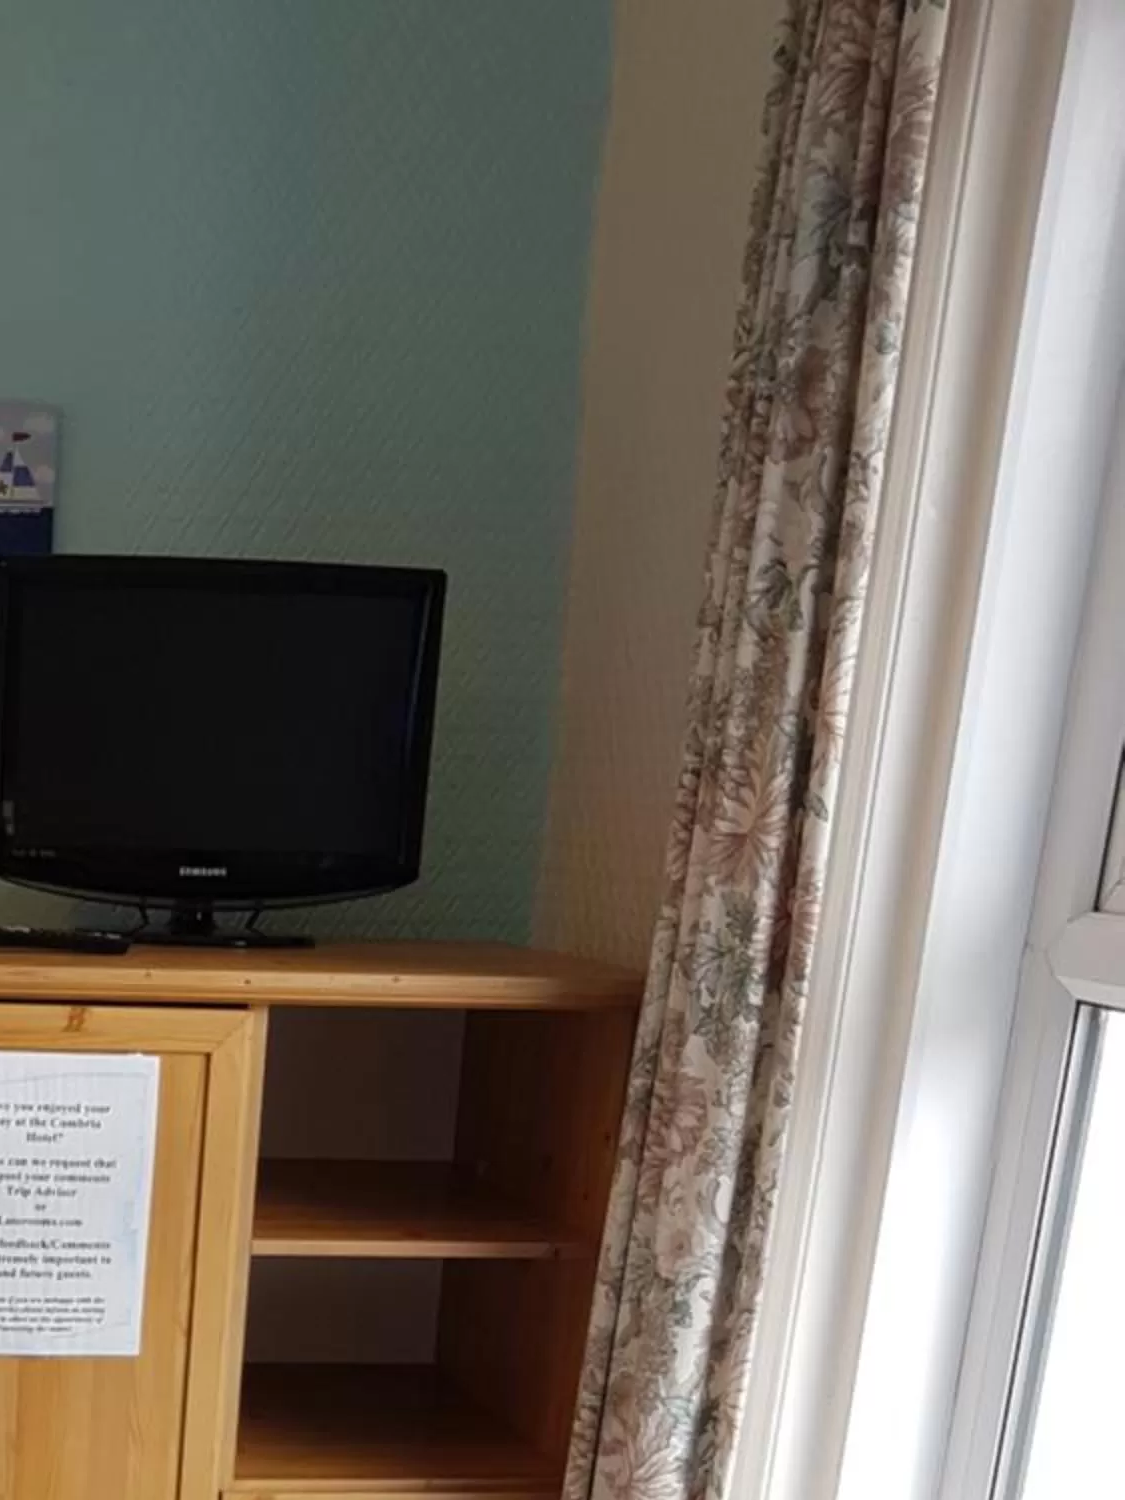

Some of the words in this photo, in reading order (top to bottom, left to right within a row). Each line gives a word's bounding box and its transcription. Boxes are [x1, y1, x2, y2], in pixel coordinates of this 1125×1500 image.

[179, 866, 227, 877] SAMSUNG
[13, 1103, 34, 1115] you
[36, 1102, 81, 1115] enjoyed
[84, 1105, 111, 1116] your
[14, 1118, 26, 1127] at
[28, 1117, 47, 1127] the
[50, 1118, 102, 1129] Cumbria
[8, 1157, 28, 1166] can
[31, 1159, 46, 1167] we
[49, 1158, 92, 1170] request
[94, 1157, 118, 1169] that
[24, 1173, 51, 1184] your
[6, 1186, 32, 1198] Trip
[34, 1204, 47, 1212] or
[41, 1255, 98, 1267] important
[100, 1256, 112, 1265] to
[19, 1268, 54, 1278] future
